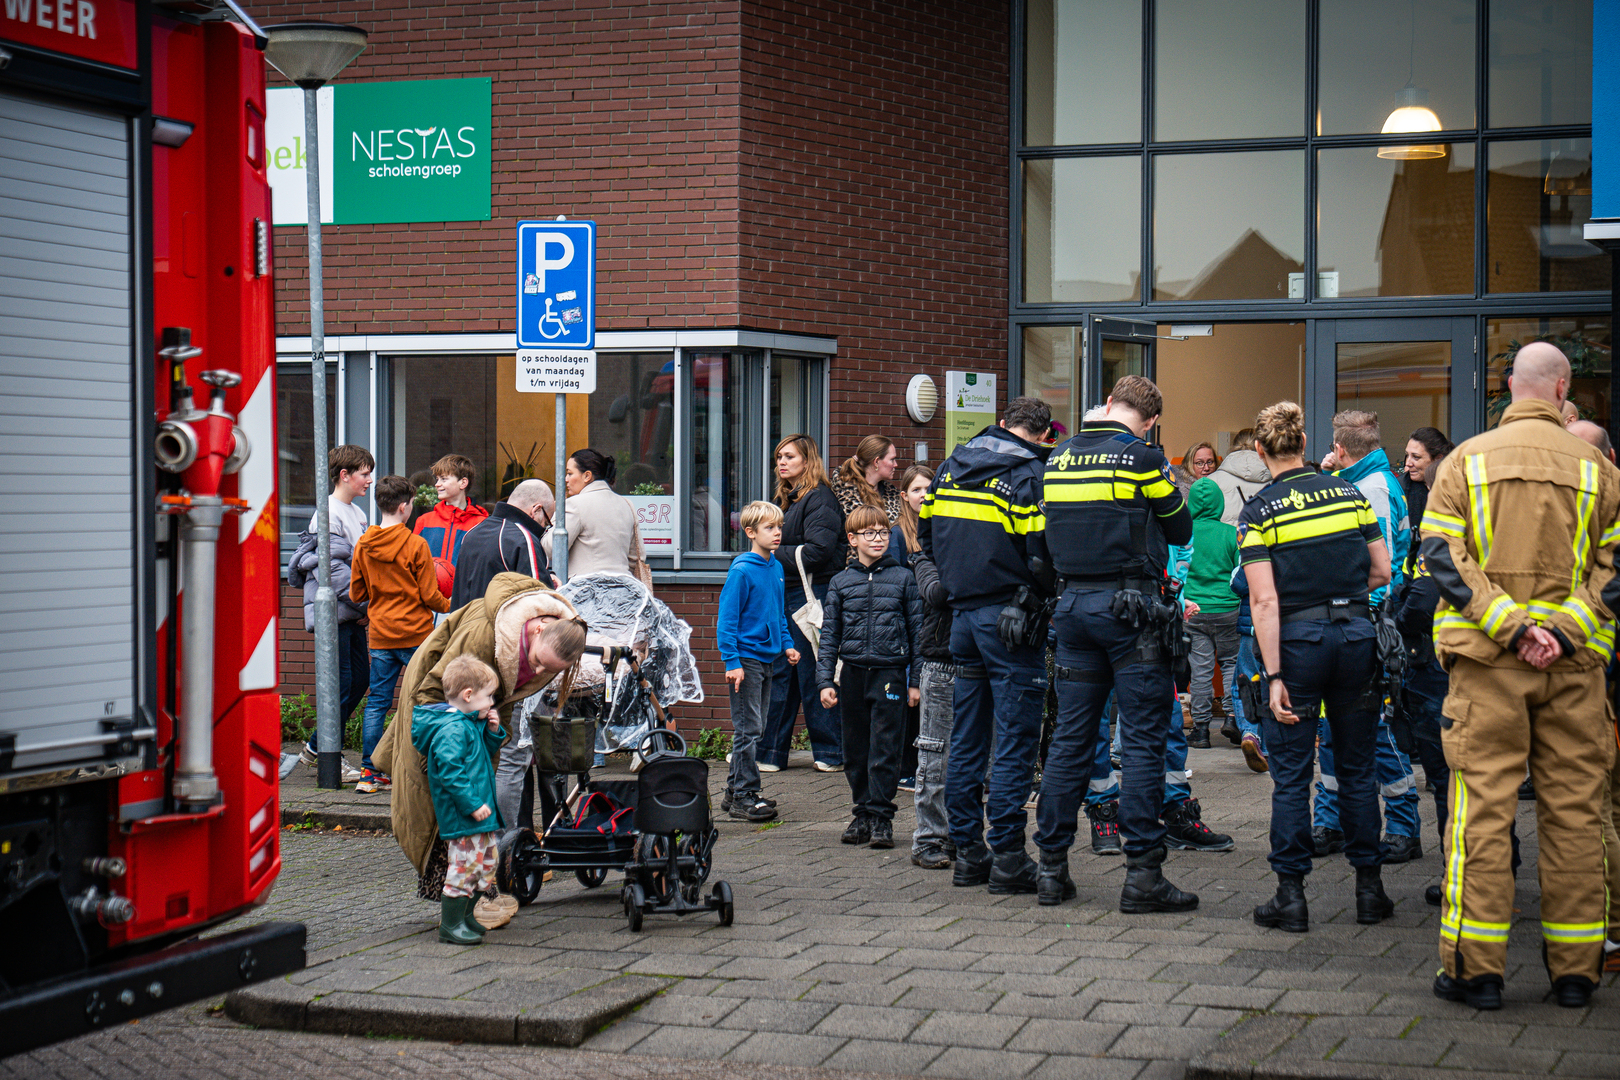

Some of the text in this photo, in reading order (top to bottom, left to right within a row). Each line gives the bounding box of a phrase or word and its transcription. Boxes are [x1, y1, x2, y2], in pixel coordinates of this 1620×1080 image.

[352, 126, 475, 161] NESTAS
[369, 163, 461, 179] scholengroep
[536, 232, 574, 293] P
[521, 354, 589, 365] op schooldagen
[526, 367, 585, 377] van maandag
[530, 378, 580, 389] t/m vrijdag
[1052, 449, 1107, 470] POLITIE
[1281, 488, 1343, 510] POLITIE
